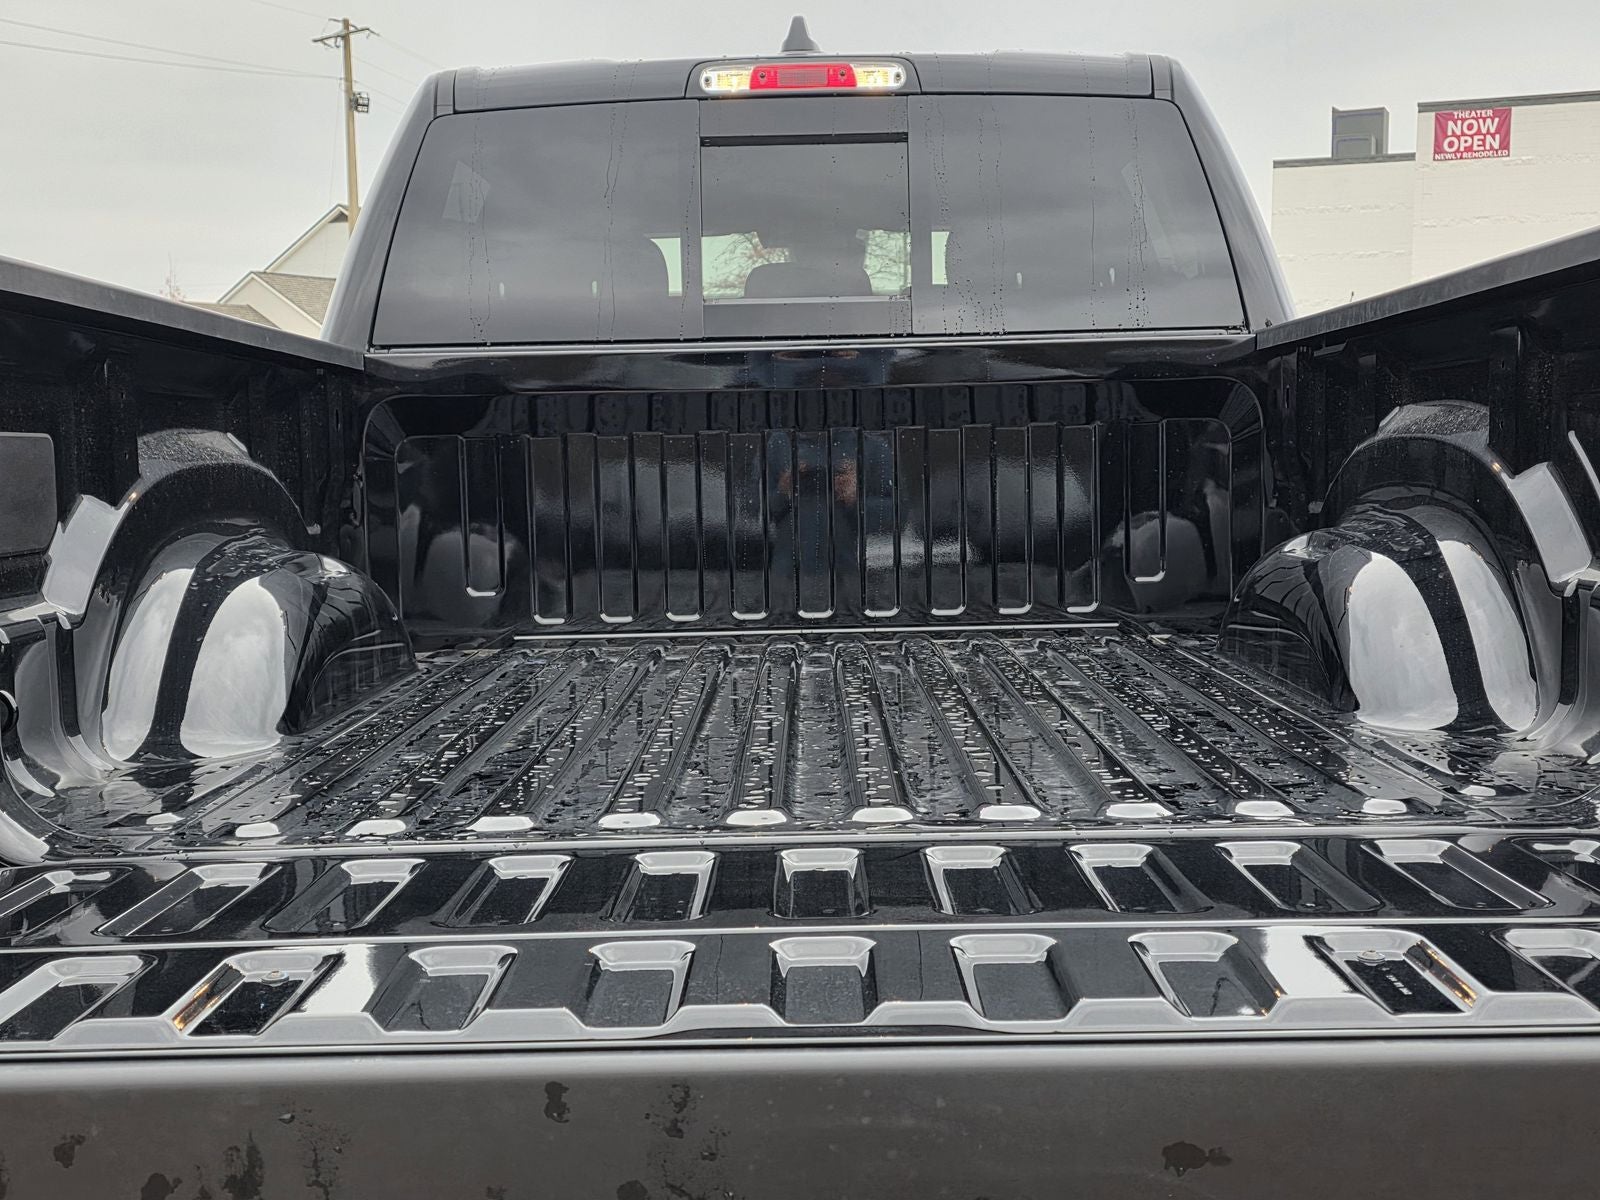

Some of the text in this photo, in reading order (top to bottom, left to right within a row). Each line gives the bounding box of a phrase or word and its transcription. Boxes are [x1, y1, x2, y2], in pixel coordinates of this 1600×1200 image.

[1453, 109, 1494, 119] THEATER
[1447, 117, 1500, 136] NOW
[1442, 134, 1500, 153] OPEN
[1434, 149, 1509, 160] NEWLY REMODELED
